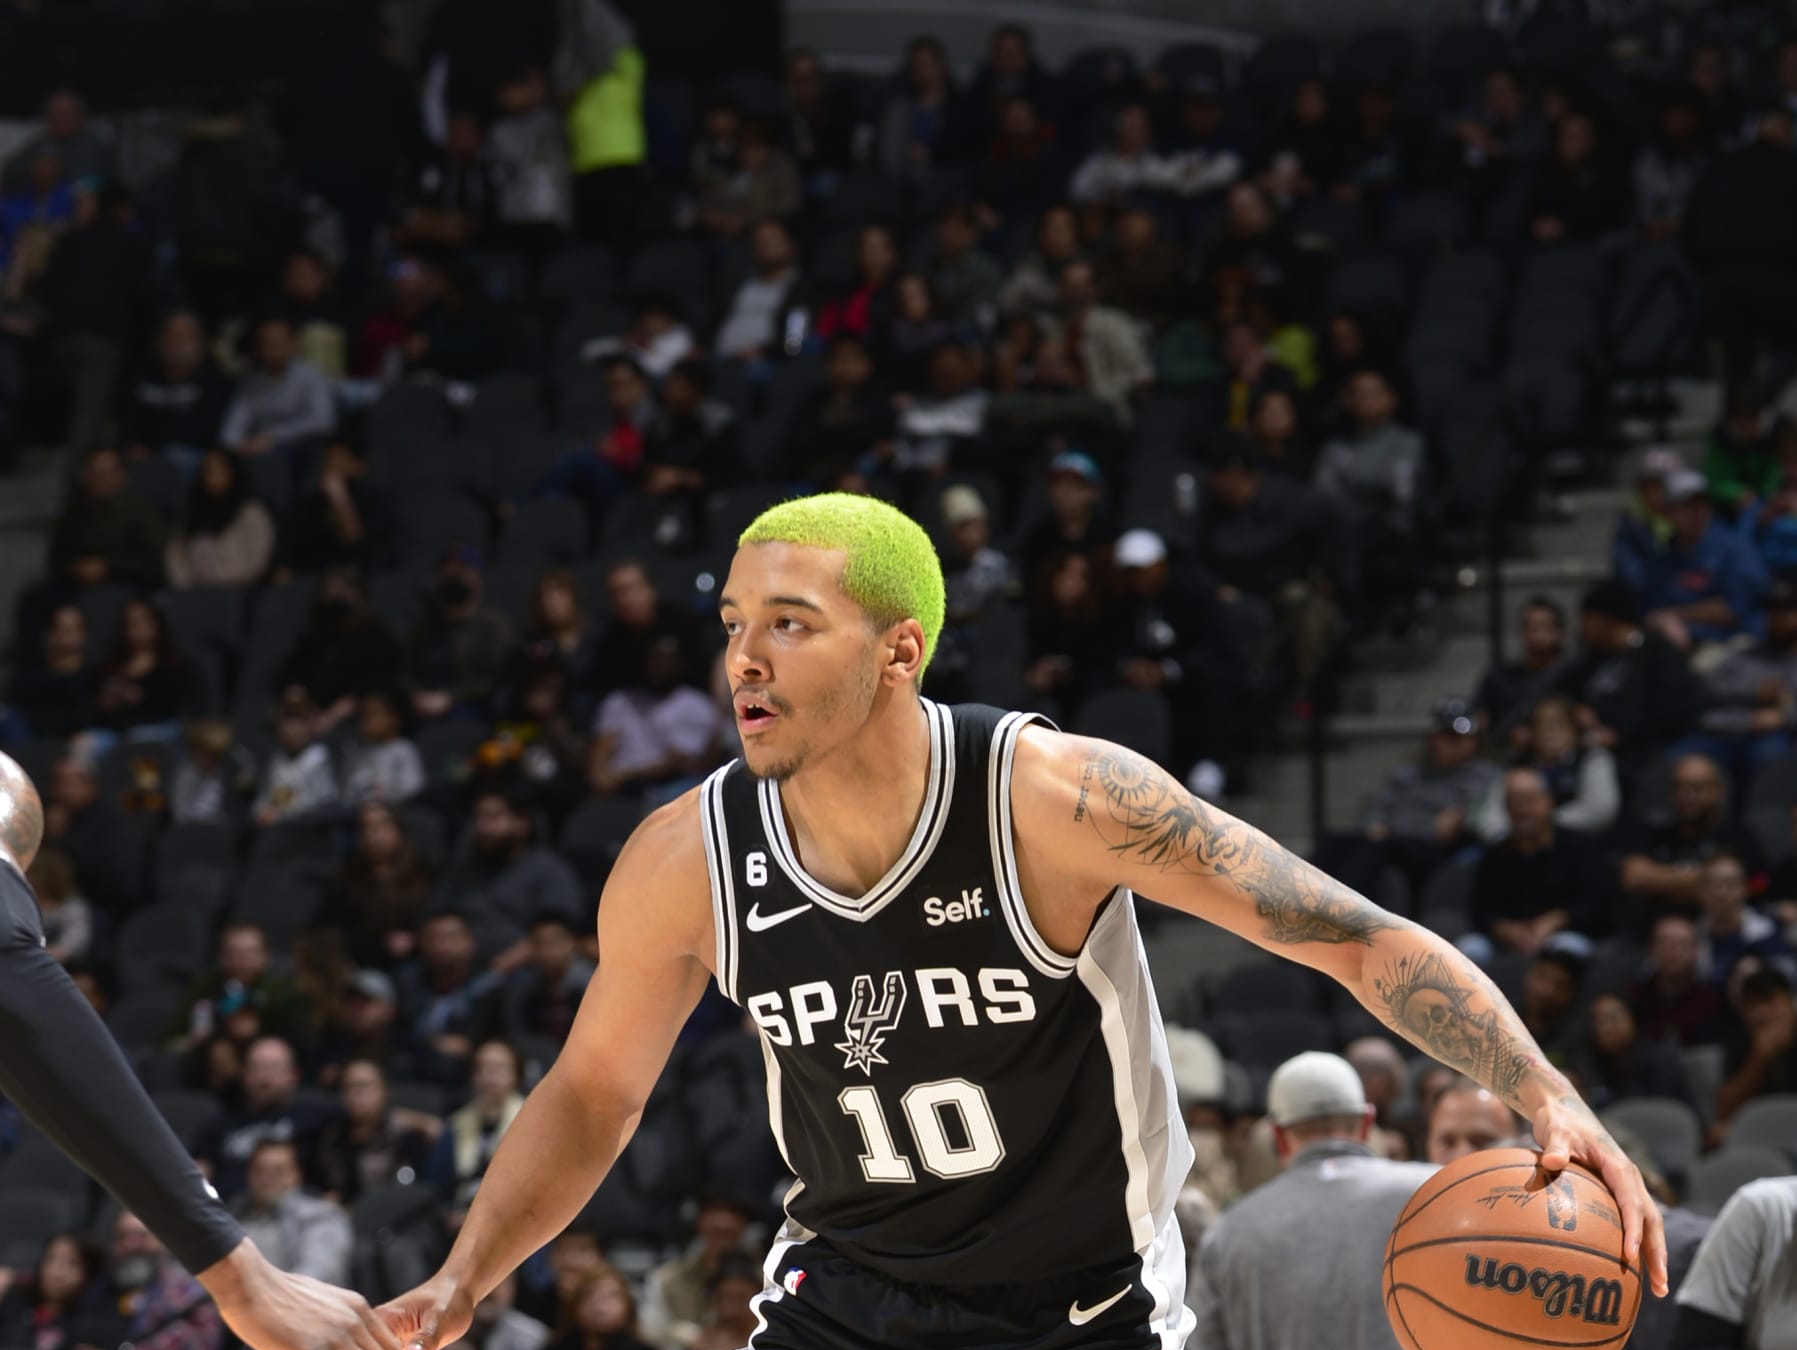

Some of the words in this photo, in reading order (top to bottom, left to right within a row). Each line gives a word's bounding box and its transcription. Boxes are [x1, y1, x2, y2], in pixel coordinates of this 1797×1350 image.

[745, 851, 768, 887] 6
[923, 888, 990, 927] Self.
[837, 1078, 1006, 1183] 10
[1465, 1253, 1623, 1326] Wilson
